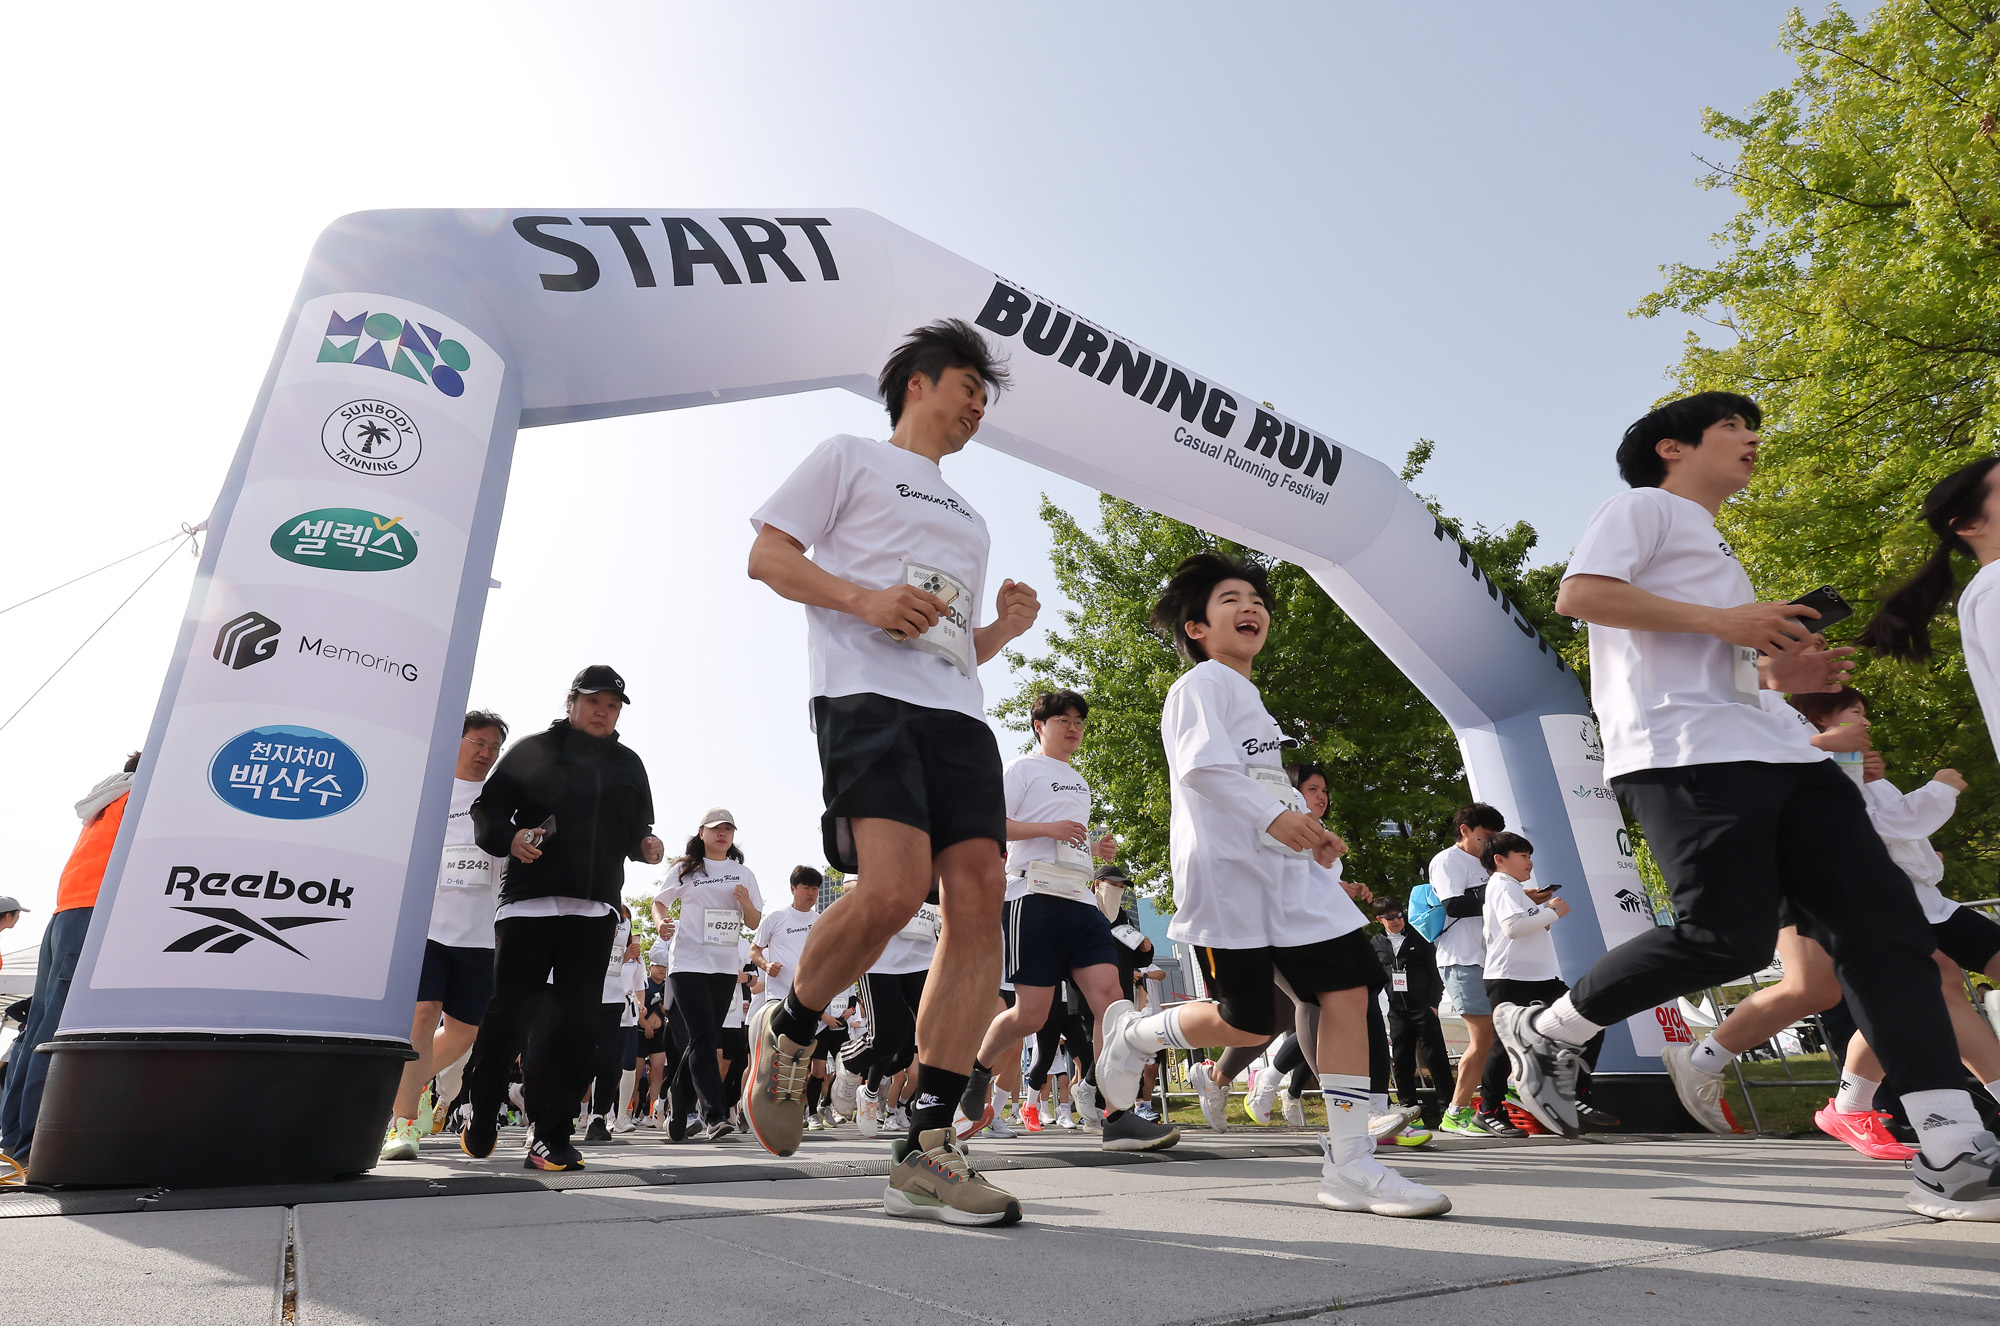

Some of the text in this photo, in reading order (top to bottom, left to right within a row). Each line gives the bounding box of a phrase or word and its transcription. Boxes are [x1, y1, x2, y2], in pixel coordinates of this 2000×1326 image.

[512, 215, 840, 292] START
[974, 280, 1238, 439] BURNING
[1244, 407, 1343, 487] RUN
[340, 403, 414, 435] SUNBODY
[336, 448, 398, 472] TANNING
[1173, 426, 1330, 506] Casual Running Festival
[896, 483, 949, 510] Burning
[288, 518, 405, 561] 셀렉스
[937, 605, 968, 635] 204
[298, 635, 418, 682] MemorinG
[250, 741, 336, 770] 천지차이
[229, 763, 343, 807] 백산수
[1051, 782, 1079, 793] Burning
[457, 860, 489, 870] 5242
[164, 865, 355, 909] Reebok
[692, 878, 724, 887] Burning
[715, 922, 739, 930] 6327
[786, 925, 809, 935] Burning
[920, 1092, 940, 1104] NIKE
[1923, 1120, 1958, 1131] adidas
